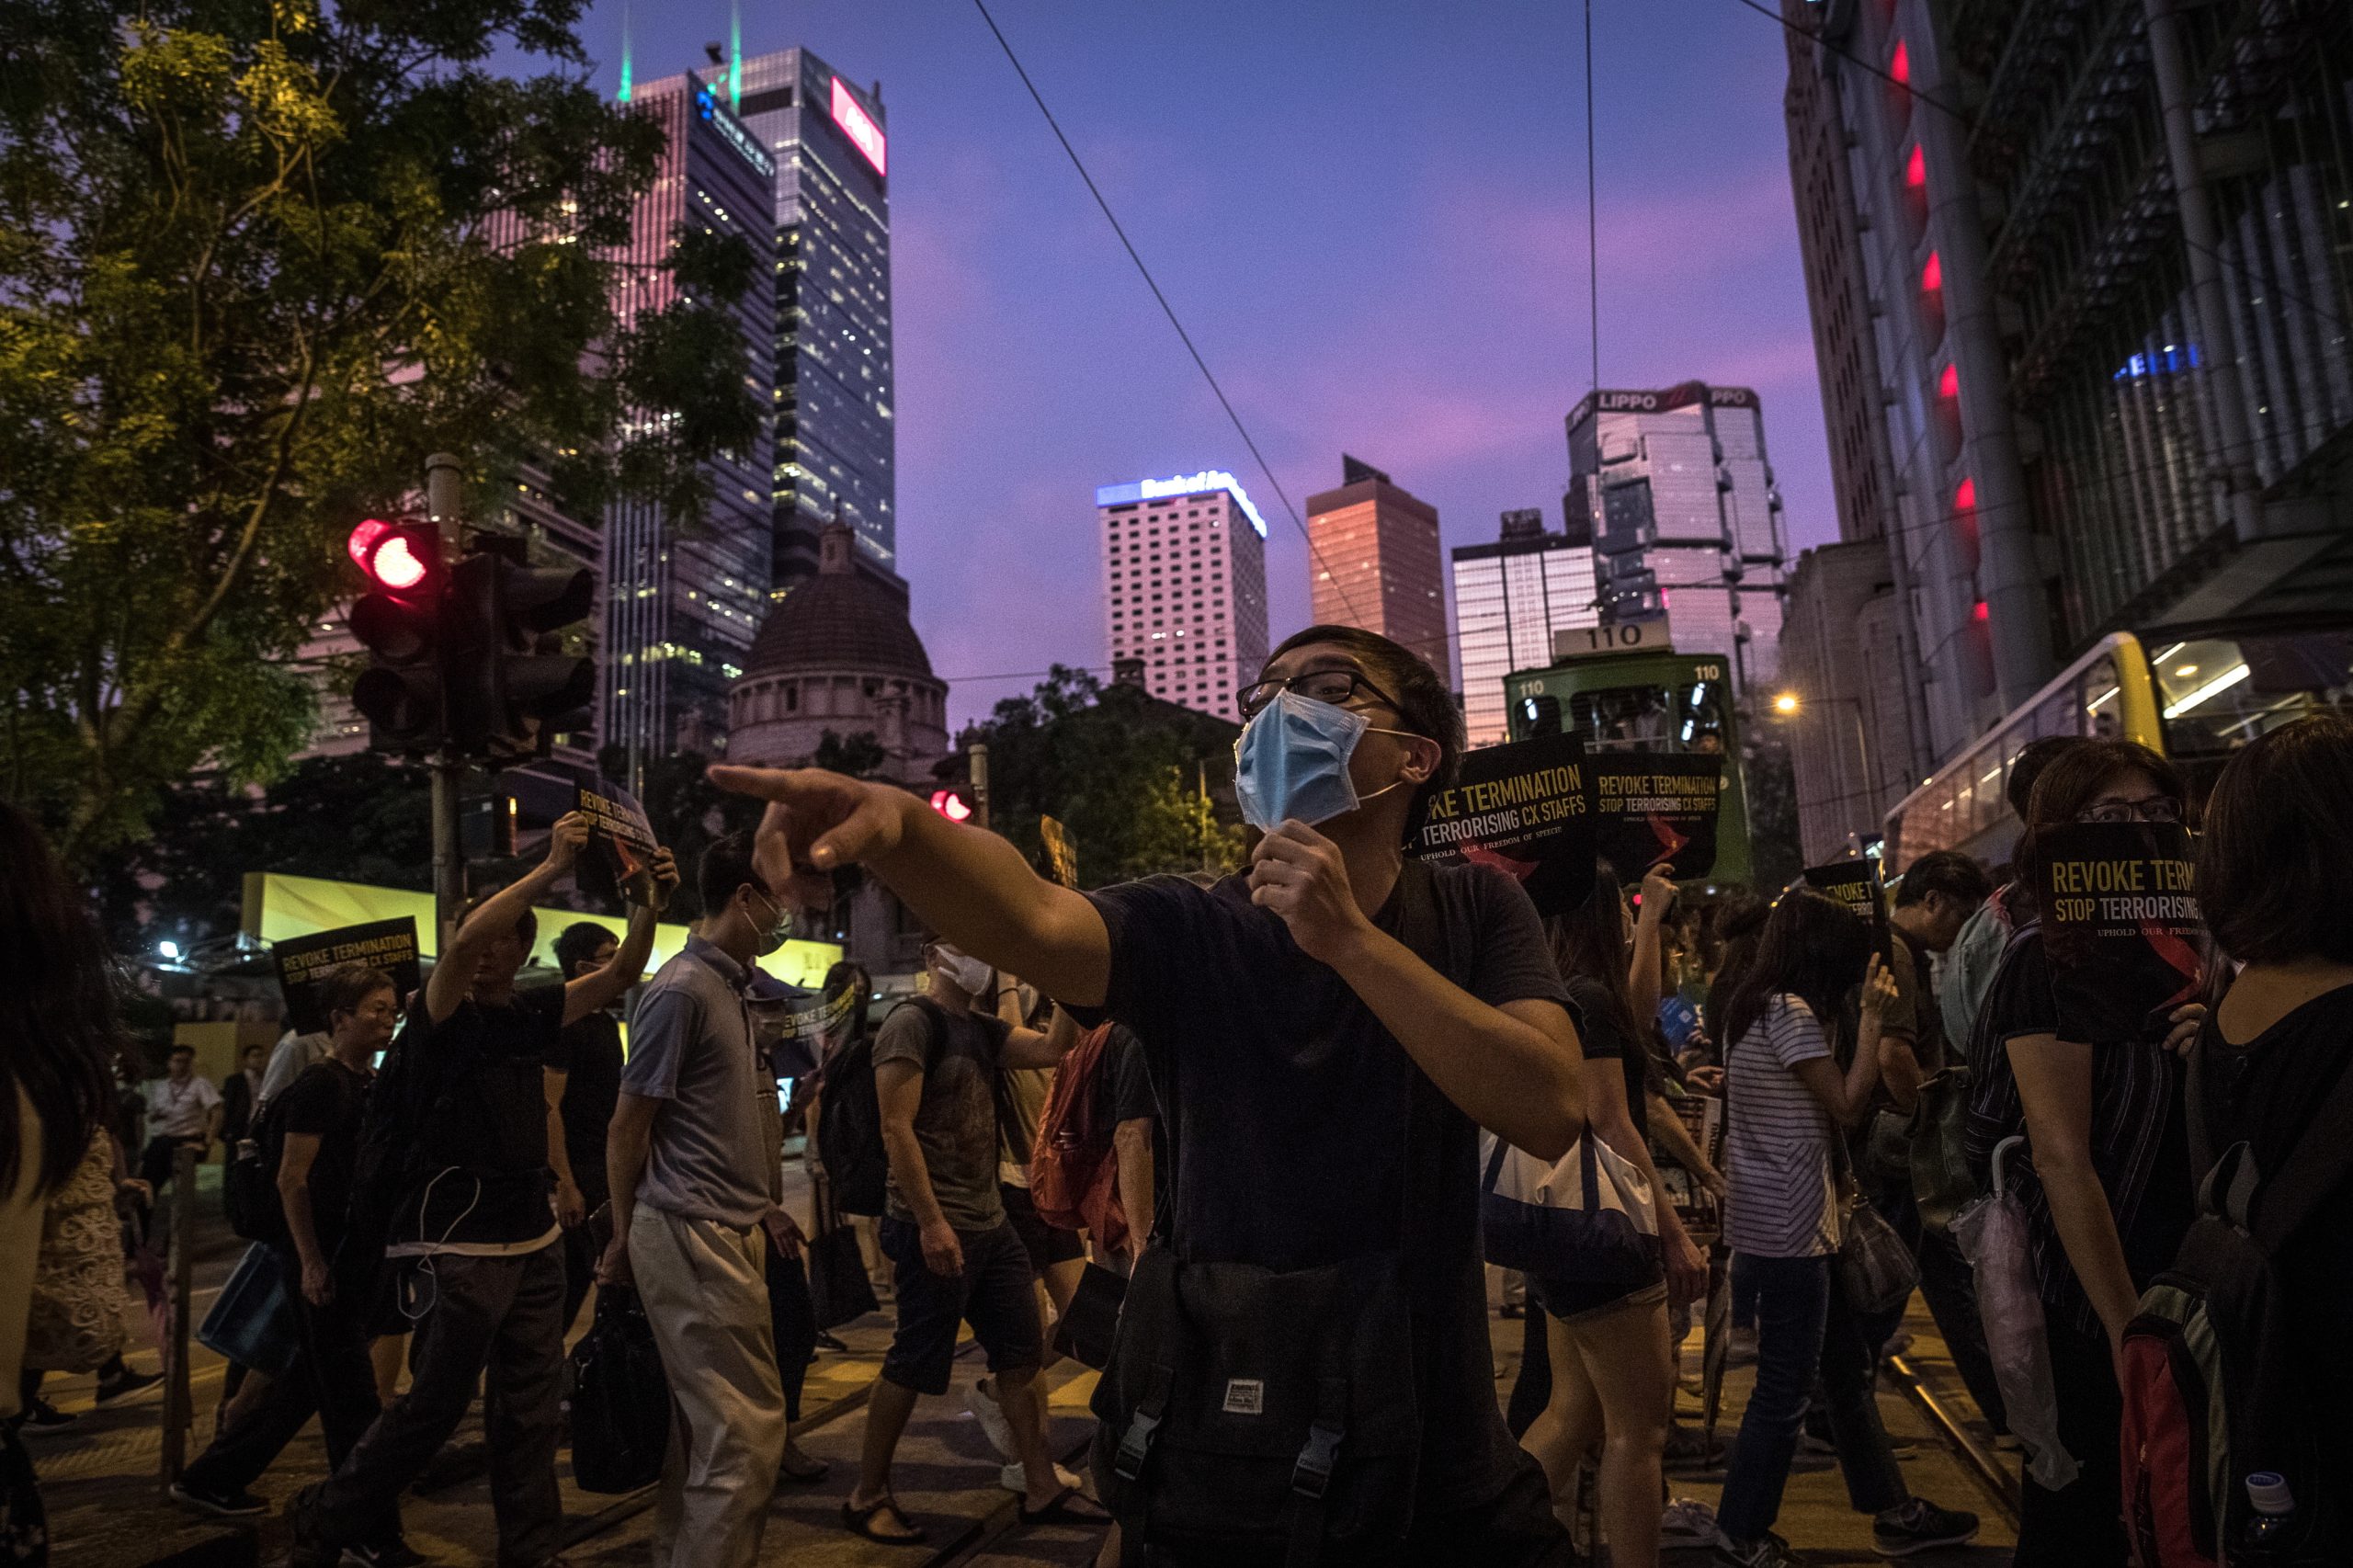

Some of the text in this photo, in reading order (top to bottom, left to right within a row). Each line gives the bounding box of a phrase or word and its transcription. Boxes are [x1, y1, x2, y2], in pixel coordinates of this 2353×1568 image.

[1599, 393, 1656, 409] LIPPO
[1711, 391, 1746, 404] PPO
[1587, 624, 1643, 649] 110
[1694, 665, 1721, 680] 110
[1519, 680, 1544, 696] 110
[1461, 764, 1583, 813] TERMINATION
[1598, 775, 1716, 796] REVOKE TERMINATION
[1599, 798, 1624, 812] STOP
[1625, 798, 1682, 812] TERRORISING
[1693, 798, 1716, 812] STAFFS
[1422, 795, 1587, 846] TERRORISING CX STAFFS
[1420, 848, 1457, 862] UPHOLD
[1461, 845, 1480, 854] OUR
[1483, 836, 1520, 851] FREEDOM
[1523, 833, 1533, 841] OF
[2052, 860, 2145, 892] REVOKE
[2055, 895, 2199, 922] STOP TERRORISING
[2097, 928, 2136, 937] UPHOLD
[2142, 927, 2163, 936] OUR
[282, 948, 331, 973] REVOKE
[332, 933, 413, 961] TERMINATION
